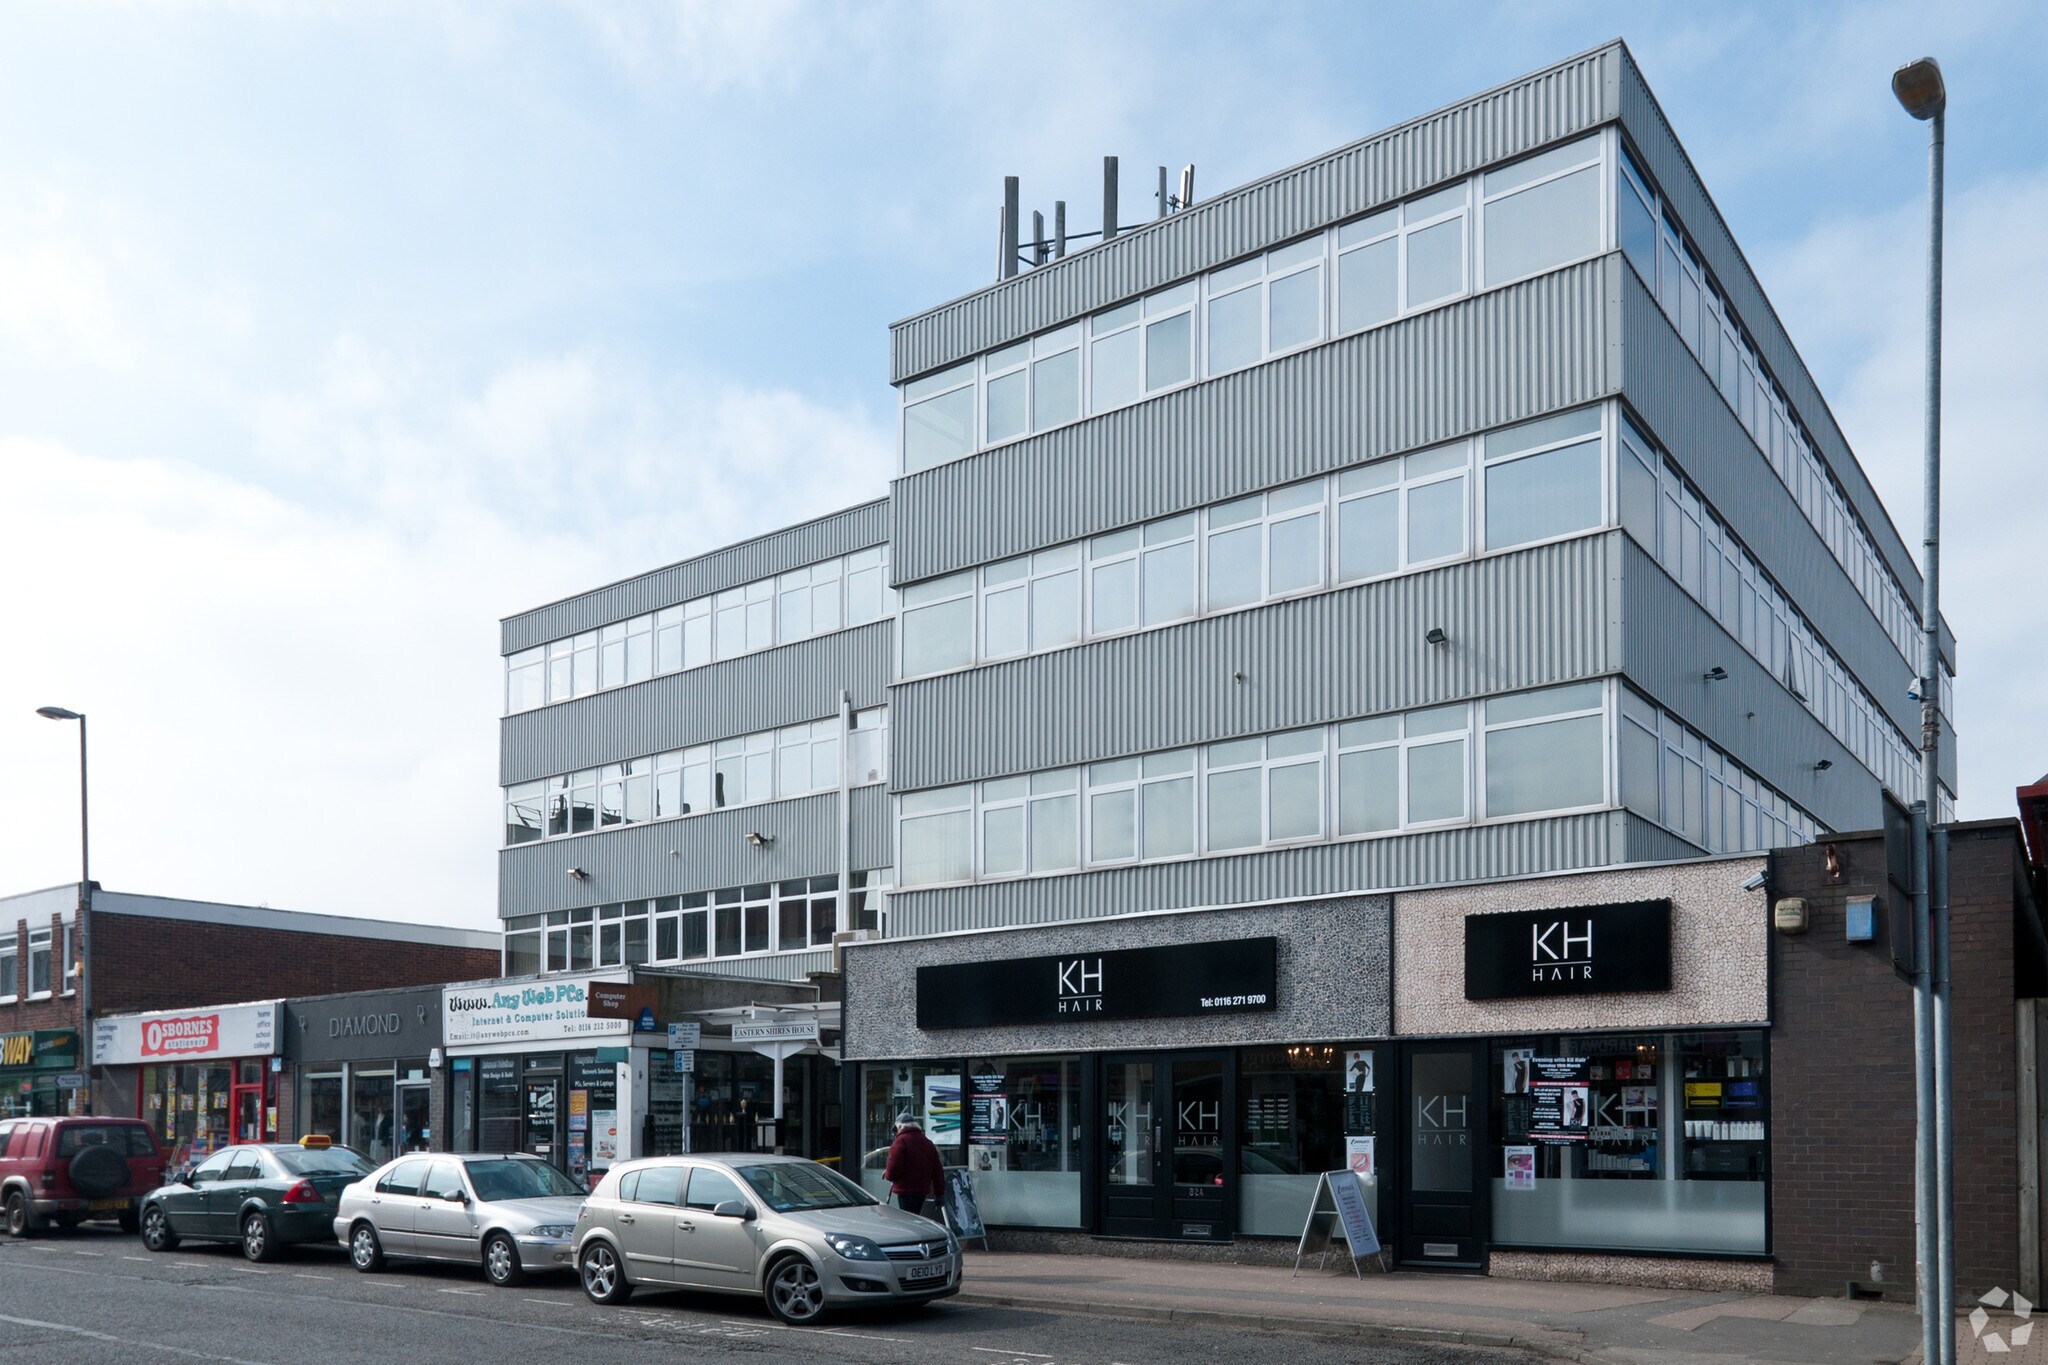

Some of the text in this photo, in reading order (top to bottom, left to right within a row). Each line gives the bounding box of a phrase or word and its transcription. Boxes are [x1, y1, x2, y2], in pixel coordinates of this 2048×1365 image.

[1533, 919, 1592, 961] KH
[1059, 958, 1102, 994] KH
[1533, 966, 1592, 981] HAIR
[595, 991, 626, 1001] Computer
[1201, 994, 1266, 1007] Tel: 0116 271 9700
[603, 1000, 619, 1009] Shop
[1059, 999, 1102, 1013] HAIR
[329, 1013, 400, 1037] DIAMOND
[472, 1015, 504, 1026] Internet
[514, 1011, 553, 1024] Computer
[556, 1008, 585, 1019] Solutio
[147, 1019, 213, 1051] OSBORNES
[734, 1026, 815, 1037] EASTERN SHIRES HOUSE
[167, 1039, 206, 1048] stationers
[1007, 1103, 1042, 1130] KH
[1114, 1102, 1150, 1129] KH
[1179, 1101, 1218, 1130] KH
[1419, 1095, 1466, 1127] KH
[1594, 1093, 1649, 1127] KH
[1178, 1136, 1218, 1146] HAIR
[1418, 1134, 1466, 1145] HAIR
[1188, 1187, 1204, 1196] 82A
